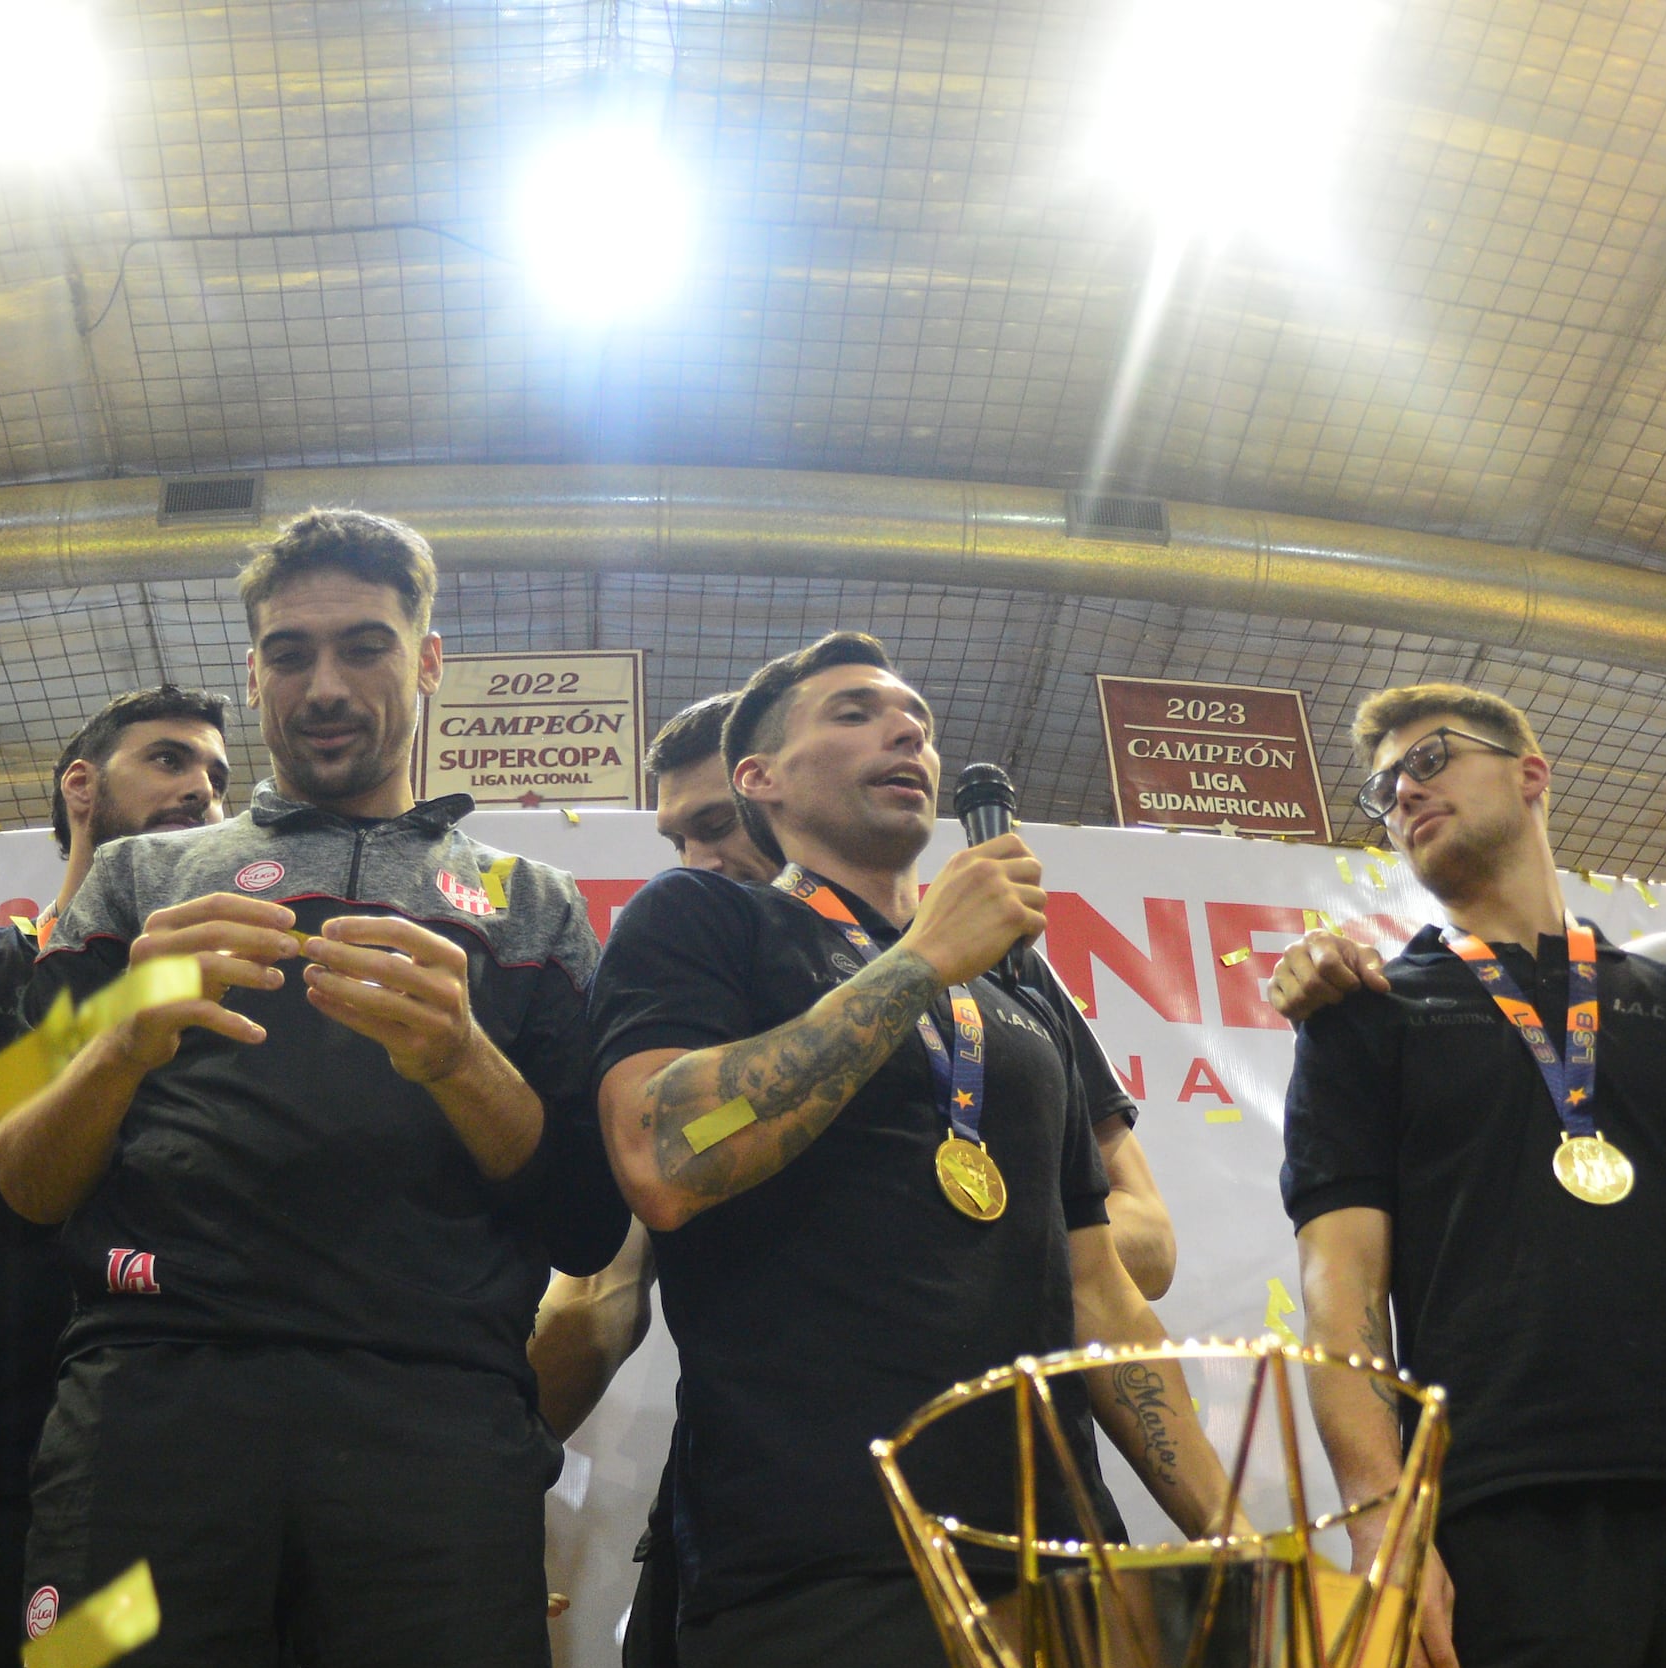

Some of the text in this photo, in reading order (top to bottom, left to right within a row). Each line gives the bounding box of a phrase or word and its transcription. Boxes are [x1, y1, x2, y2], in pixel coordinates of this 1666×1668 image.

[487, 672, 579, 696] 2022
[440, 709, 625, 737] CAMPEÓN
[1166, 698, 1246, 725] 2023
[439, 746, 622, 770] SUPERCOPA
[1127, 738, 1296, 770] CAMPEÓN
[471, 772, 593, 787] LIGA NACIONAL
[1189, 771, 1247, 793] LIGA
[1139, 792, 1306, 818] SUDAMERICANA
[960, 1007, 984, 1064] LSB
[1512, 1012, 1556, 1064] LSB
[1571, 1012, 1596, 1063] LSB
